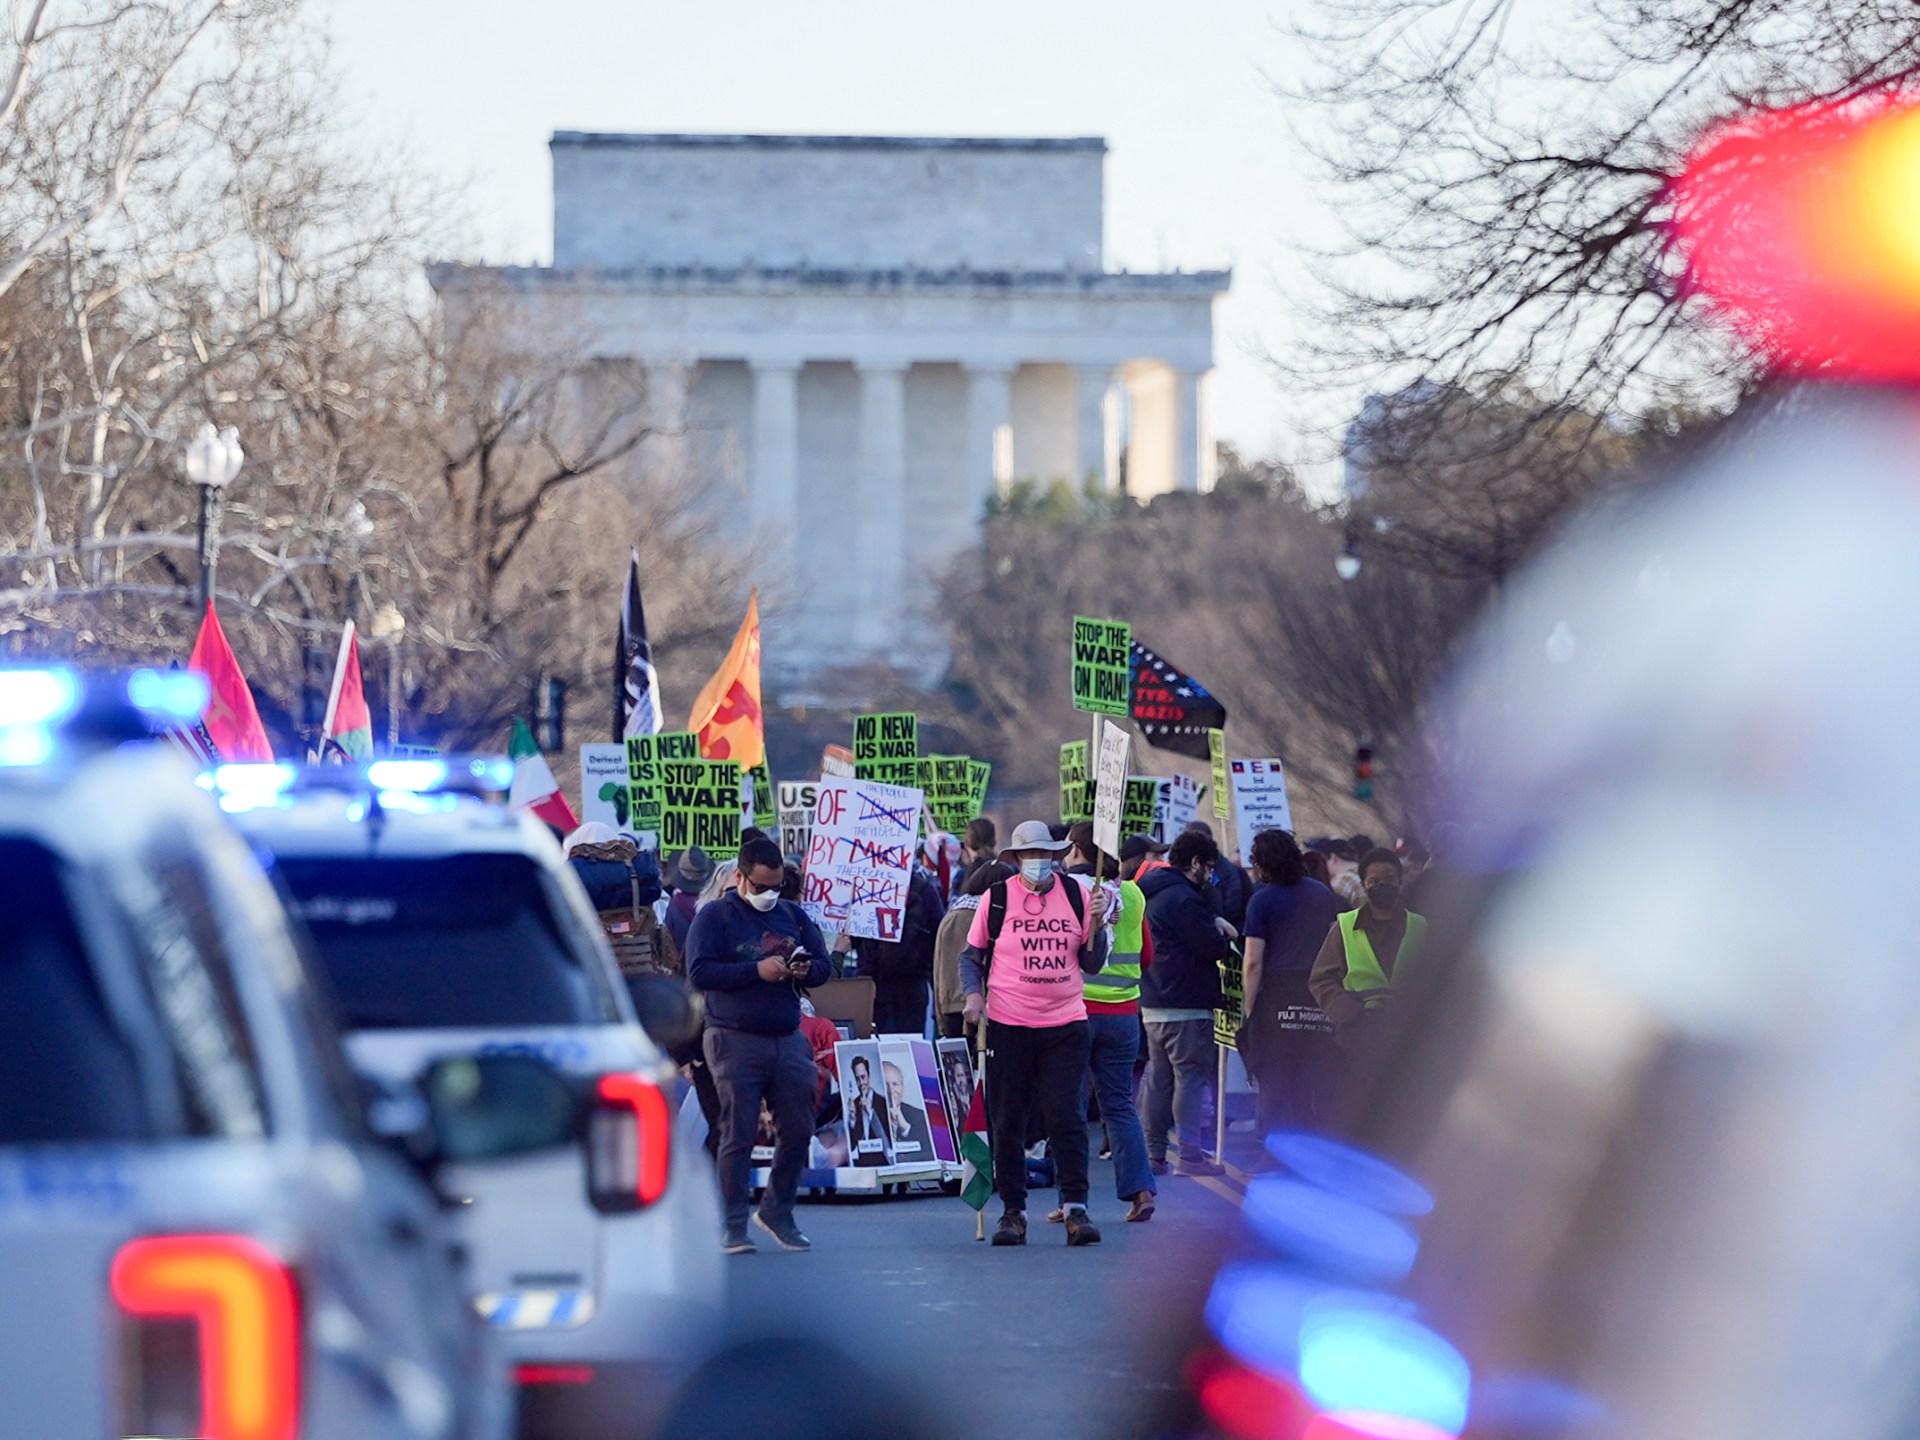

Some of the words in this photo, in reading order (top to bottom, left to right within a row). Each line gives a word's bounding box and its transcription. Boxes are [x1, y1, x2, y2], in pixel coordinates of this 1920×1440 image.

[1075, 622, 1103, 642] STOP
[1105, 627, 1127, 647] THE
[1075, 643, 1127, 667] WAR
[1075, 665, 1091, 698] ON
[1095, 668, 1127, 702] IRAN!
[856, 717, 877, 741] NO
[880, 715, 914, 740] NEW
[627, 739, 652, 763] NO
[656, 734, 697, 760] NEW
[855, 742, 877, 760] US
[879, 741, 916, 759] WAR
[587, 767, 627, 776] Imperial
[629, 764, 654, 780] US
[664, 764, 705, 786] STOP
[709, 764, 739, 786] THE
[855, 765, 875, 779] IN
[877, 762, 915, 779] THE
[916, 761, 934, 782] NO
[936, 760, 968, 781] NEW
[631, 786, 654, 800] IN
[664, 786, 740, 809] WAR
[781, 787, 817, 808] US
[936, 783, 969, 797] WAR
[818, 789, 848, 825] OF
[936, 802, 969, 814] THE
[1124, 802, 1153, 817] AR
[663, 811, 688, 846] ON
[693, 813, 740, 848] IRAN!
[809, 835, 840, 865] BY
[851, 875, 907, 906] RICH
[1013, 919, 1073, 933] PEACE
[1020, 937, 1068, 951] WITH
[1024, 956, 1066, 970] IRAN
[1019, 975, 1071, 984] CODEPINK.ORG
[1278, 1011, 1295, 1021] FUJI
[1299, 1012, 1331, 1022] MOUNTA
